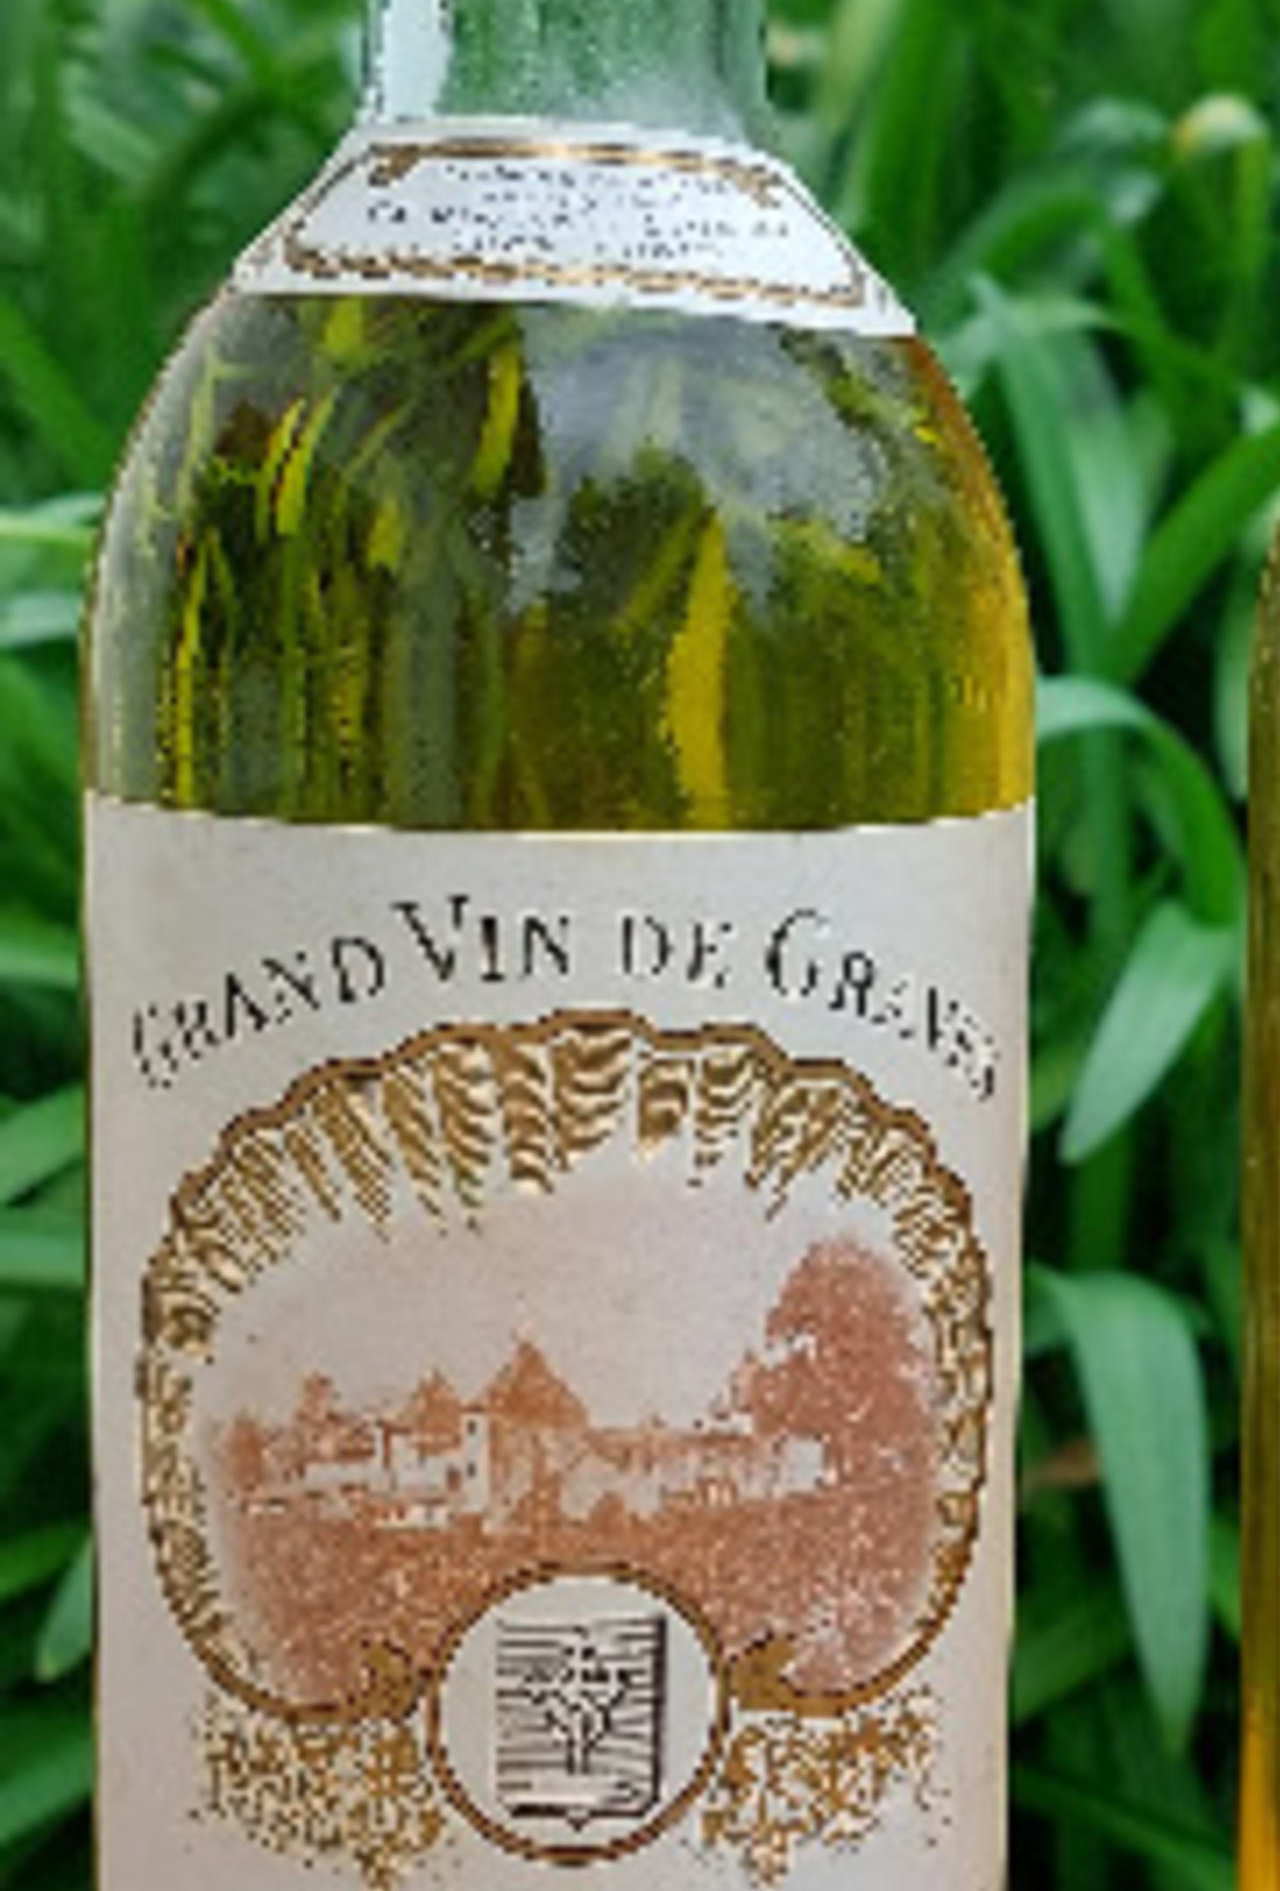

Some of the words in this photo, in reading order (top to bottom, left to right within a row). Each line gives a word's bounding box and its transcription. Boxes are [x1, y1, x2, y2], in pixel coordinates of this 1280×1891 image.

[131, 933, 387, 1091] GRAND
[391, 894, 569, 984] VIN
[621, 914, 732, 989] DE
